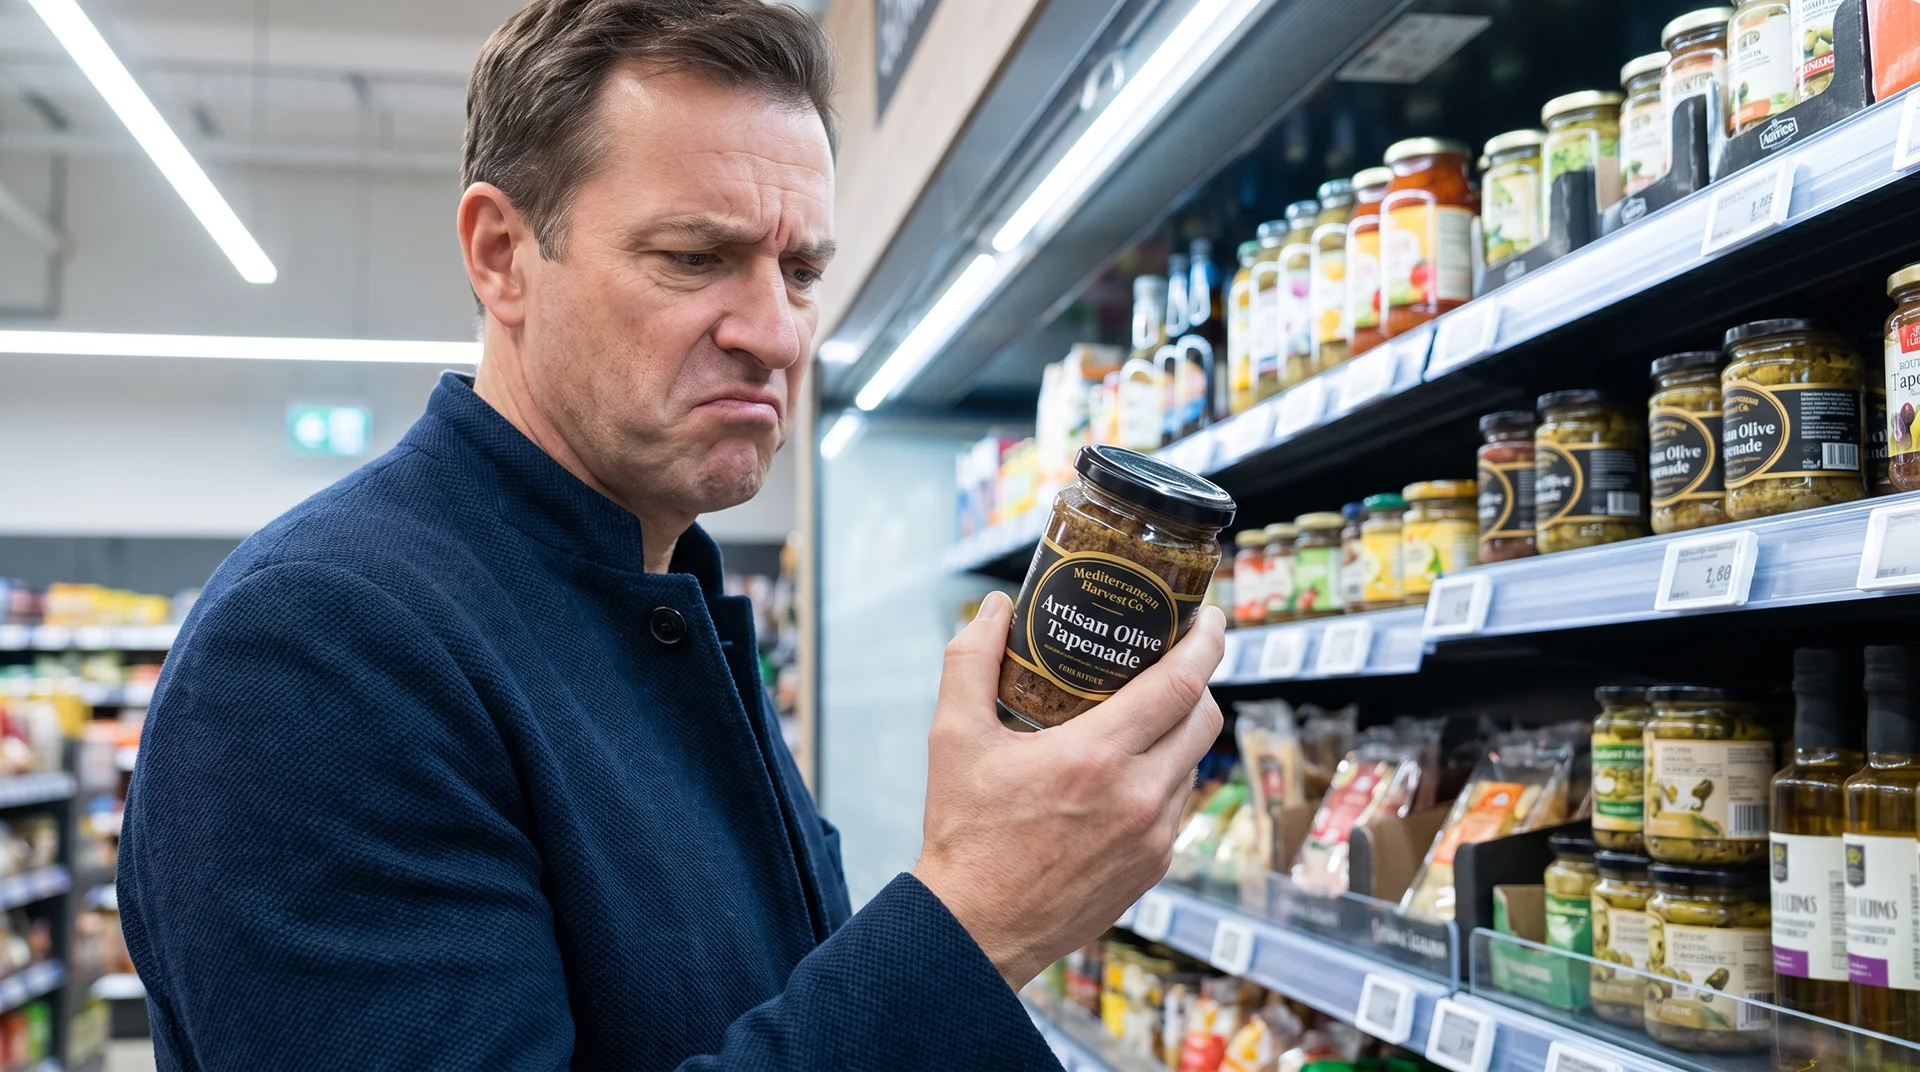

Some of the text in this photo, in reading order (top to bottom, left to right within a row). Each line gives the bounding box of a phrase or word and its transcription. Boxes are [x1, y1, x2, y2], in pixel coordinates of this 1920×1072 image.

[1739, 422, 1775, 441] Olive
[1667, 444, 1702, 460] Olive
[1074, 567, 1160, 611] Mediterranean
[1081, 580, 1145, 613] Harvest Co.
[1041, 594, 1162, 652] Artisan Olive
[1047, 618, 1141, 669] Tapenade
